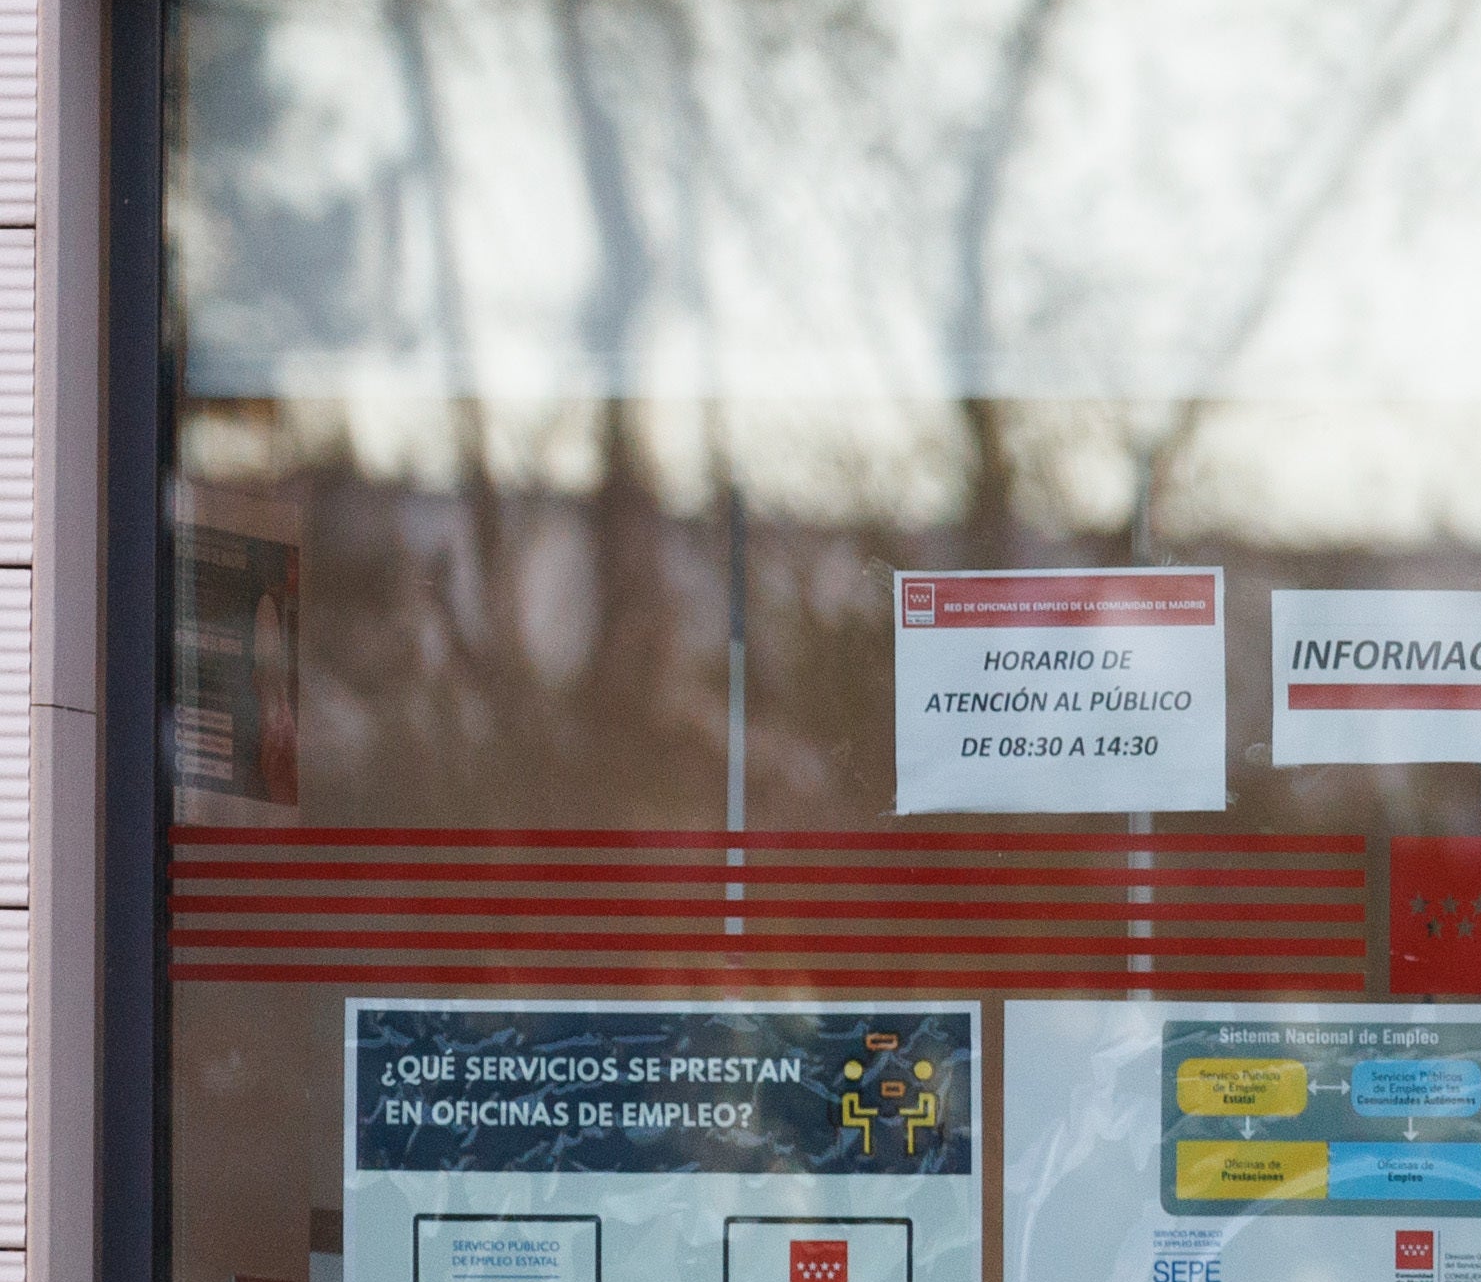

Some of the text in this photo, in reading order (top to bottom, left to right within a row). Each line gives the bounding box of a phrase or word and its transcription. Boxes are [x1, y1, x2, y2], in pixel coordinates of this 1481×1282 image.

[983, 650, 1132, 671] HORARIO DE
[925, 686, 1192, 713] ATENCIÓN AL PÚBLICO
[960, 736, 1158, 757] DE 08:30 A 14:30
[1219, 1027, 1439, 1048] Sistema Nacional de Empleo
[380, 1048, 802, 1085] ¿QUÉ SERVICIOS SE PRESTAN
[385, 1101, 753, 1128] EN OFICINAS DE EMPLEO?
